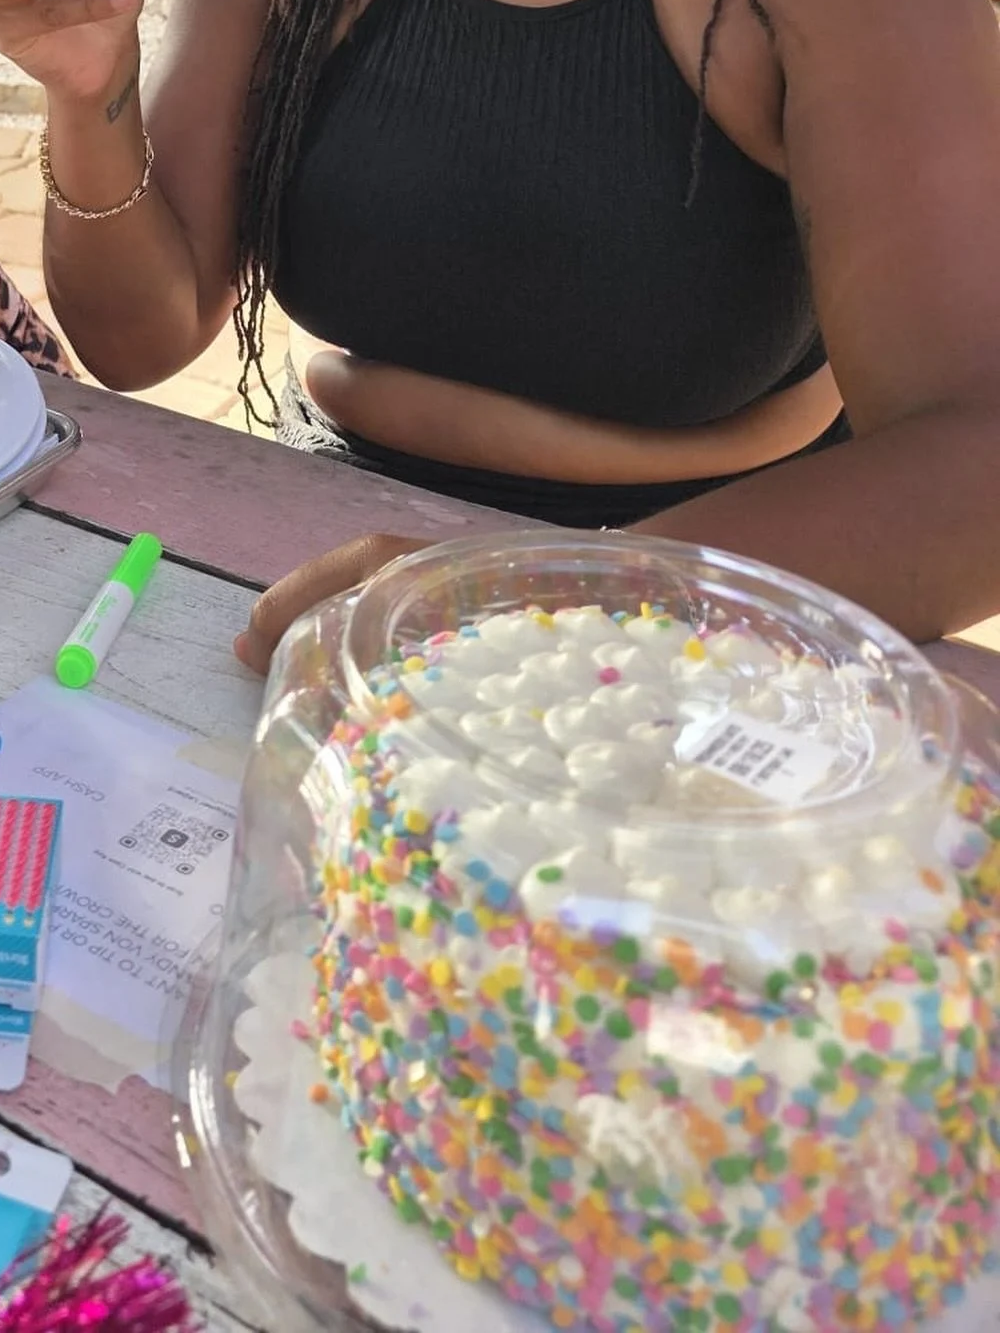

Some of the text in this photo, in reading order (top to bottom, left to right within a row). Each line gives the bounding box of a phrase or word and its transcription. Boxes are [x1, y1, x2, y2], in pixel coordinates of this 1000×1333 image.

[32, 766, 106, 802] CASH APP
[60, 927, 88, 946] OR
[112, 915, 150, 939] THE
[87, 945, 116, 963] TIP
[102, 930, 142, 956] VON
[151, 934, 190, 958] FOR
[117, 958, 143, 978] TO
